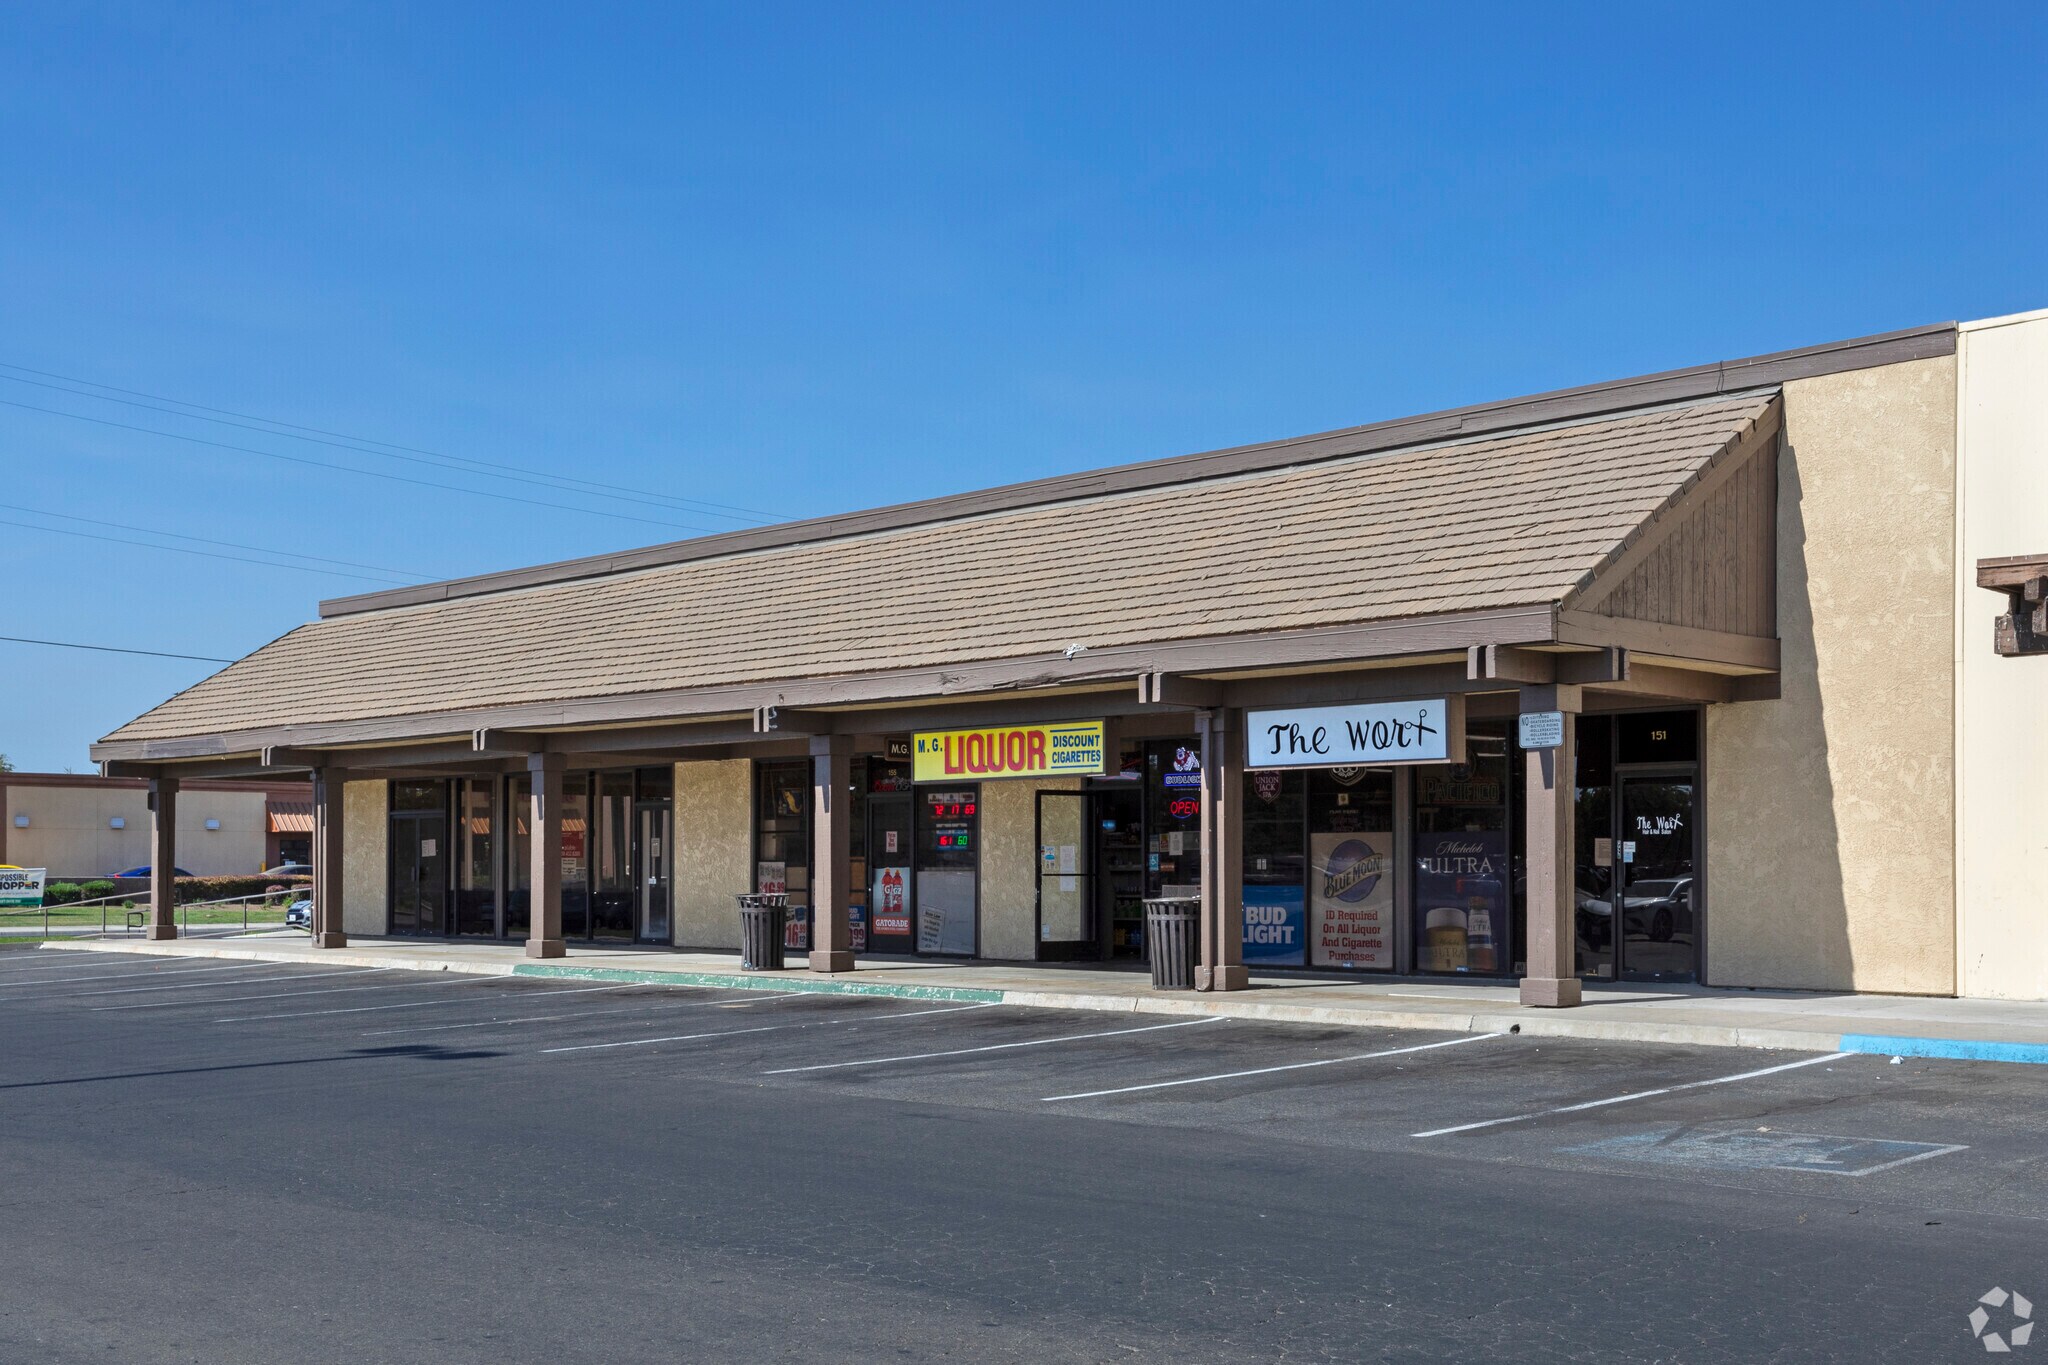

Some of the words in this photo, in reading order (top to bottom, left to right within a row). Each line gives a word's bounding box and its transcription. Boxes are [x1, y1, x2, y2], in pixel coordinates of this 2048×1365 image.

[1053, 735, 1100, 748] DISCOUNT
[1268, 722, 1330, 754] The
[1651, 731, 1667, 740] 151
[891, 744, 909, 754] M.G.
[944, 731, 1047, 775] LIQUOR
[1052, 750, 1101, 764] CIGARETTES
[1182, 776, 1201, 784] LIGH
[1255, 776, 1279, 784] UNION
[1258, 784, 1276, 792] JACK
[1424, 778, 1500, 803] PACIFICO
[951, 804, 960, 814] 17
[964, 804, 975, 814] 69
[1170, 801, 1199, 814] OPEN
[1637, 816, 1651, 829] The
[957, 836, 967, 845] 60
[1436, 841, 1484, 856] Michelob
[1428, 857, 1494, 874] ULTRA
[1324, 872, 1351, 898] BLUE
[1353, 857, 1381, 880] MOON
[1245, 906, 1287, 925] BUD
[1326, 911, 1335, 920] ID
[1338, 910, 1378, 922] Required
[876, 919, 909, 928] GATORADE
[1242, 926, 1295, 944] LIGHT
[1323, 924, 1334, 933] On
[1338, 924, 1349, 933] All
[1352, 924, 1381, 936] Liquor
[1322, 938, 1339, 948] And
[1342, 938, 1382, 949] Cigarette
[1328, 951, 1376, 961] Purchases
